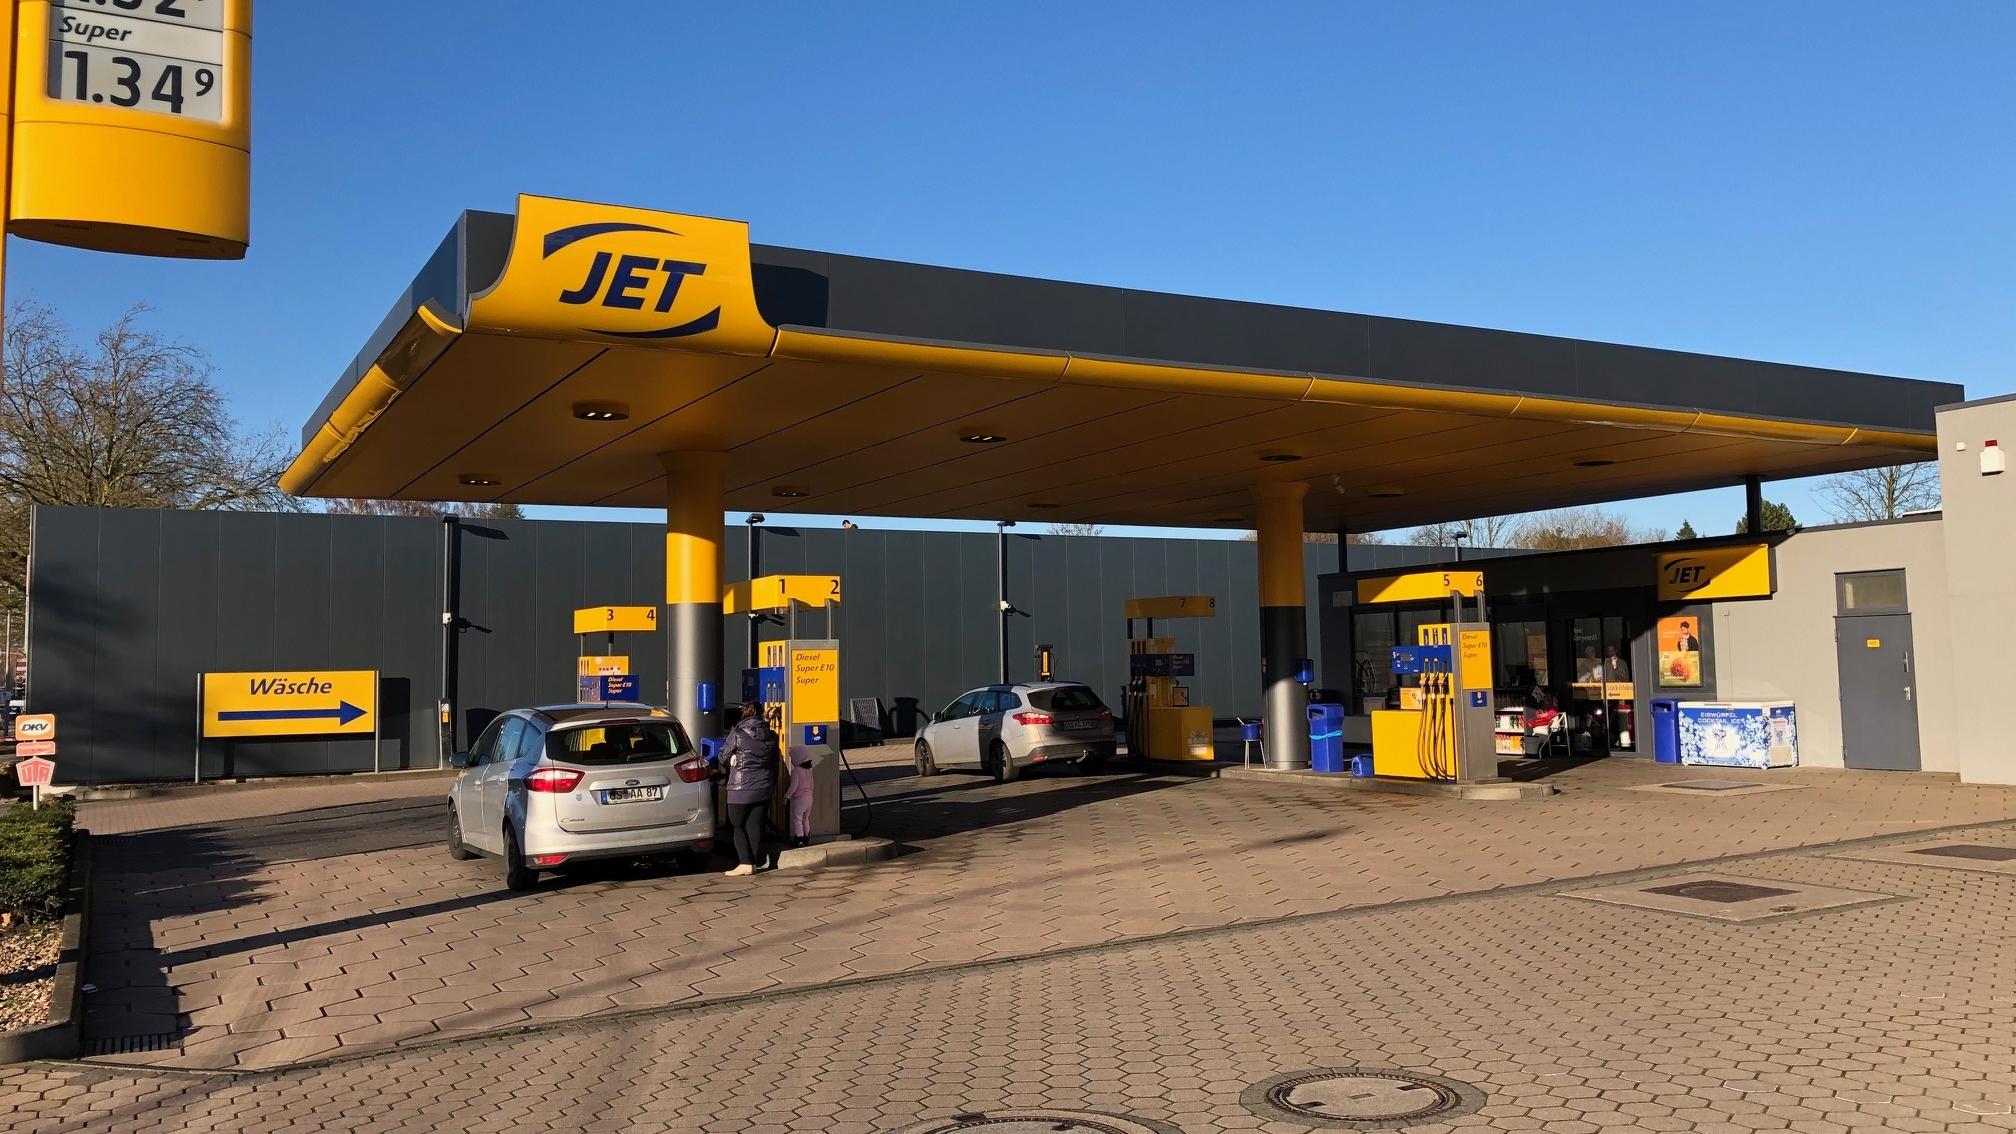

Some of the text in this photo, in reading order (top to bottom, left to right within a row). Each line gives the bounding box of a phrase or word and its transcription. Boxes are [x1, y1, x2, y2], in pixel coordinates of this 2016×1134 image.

[58, 16, 132, 43] Super
[558, 251, 707, 313] JET
[1443, 573, 1483, 587] 5 6
[1669, 565, 1705, 584] JET
[779, 578, 840, 595] 1 2
[1179, 597, 1216, 609] 7 8
[607, 608, 656, 621] 3 4
[795, 653, 821, 661] Diesel
[795, 663, 835, 674] Super E10
[250, 677, 333, 695] Wäsche
[795, 675, 820, 685] Super
[21, 723, 49, 732] DKV
